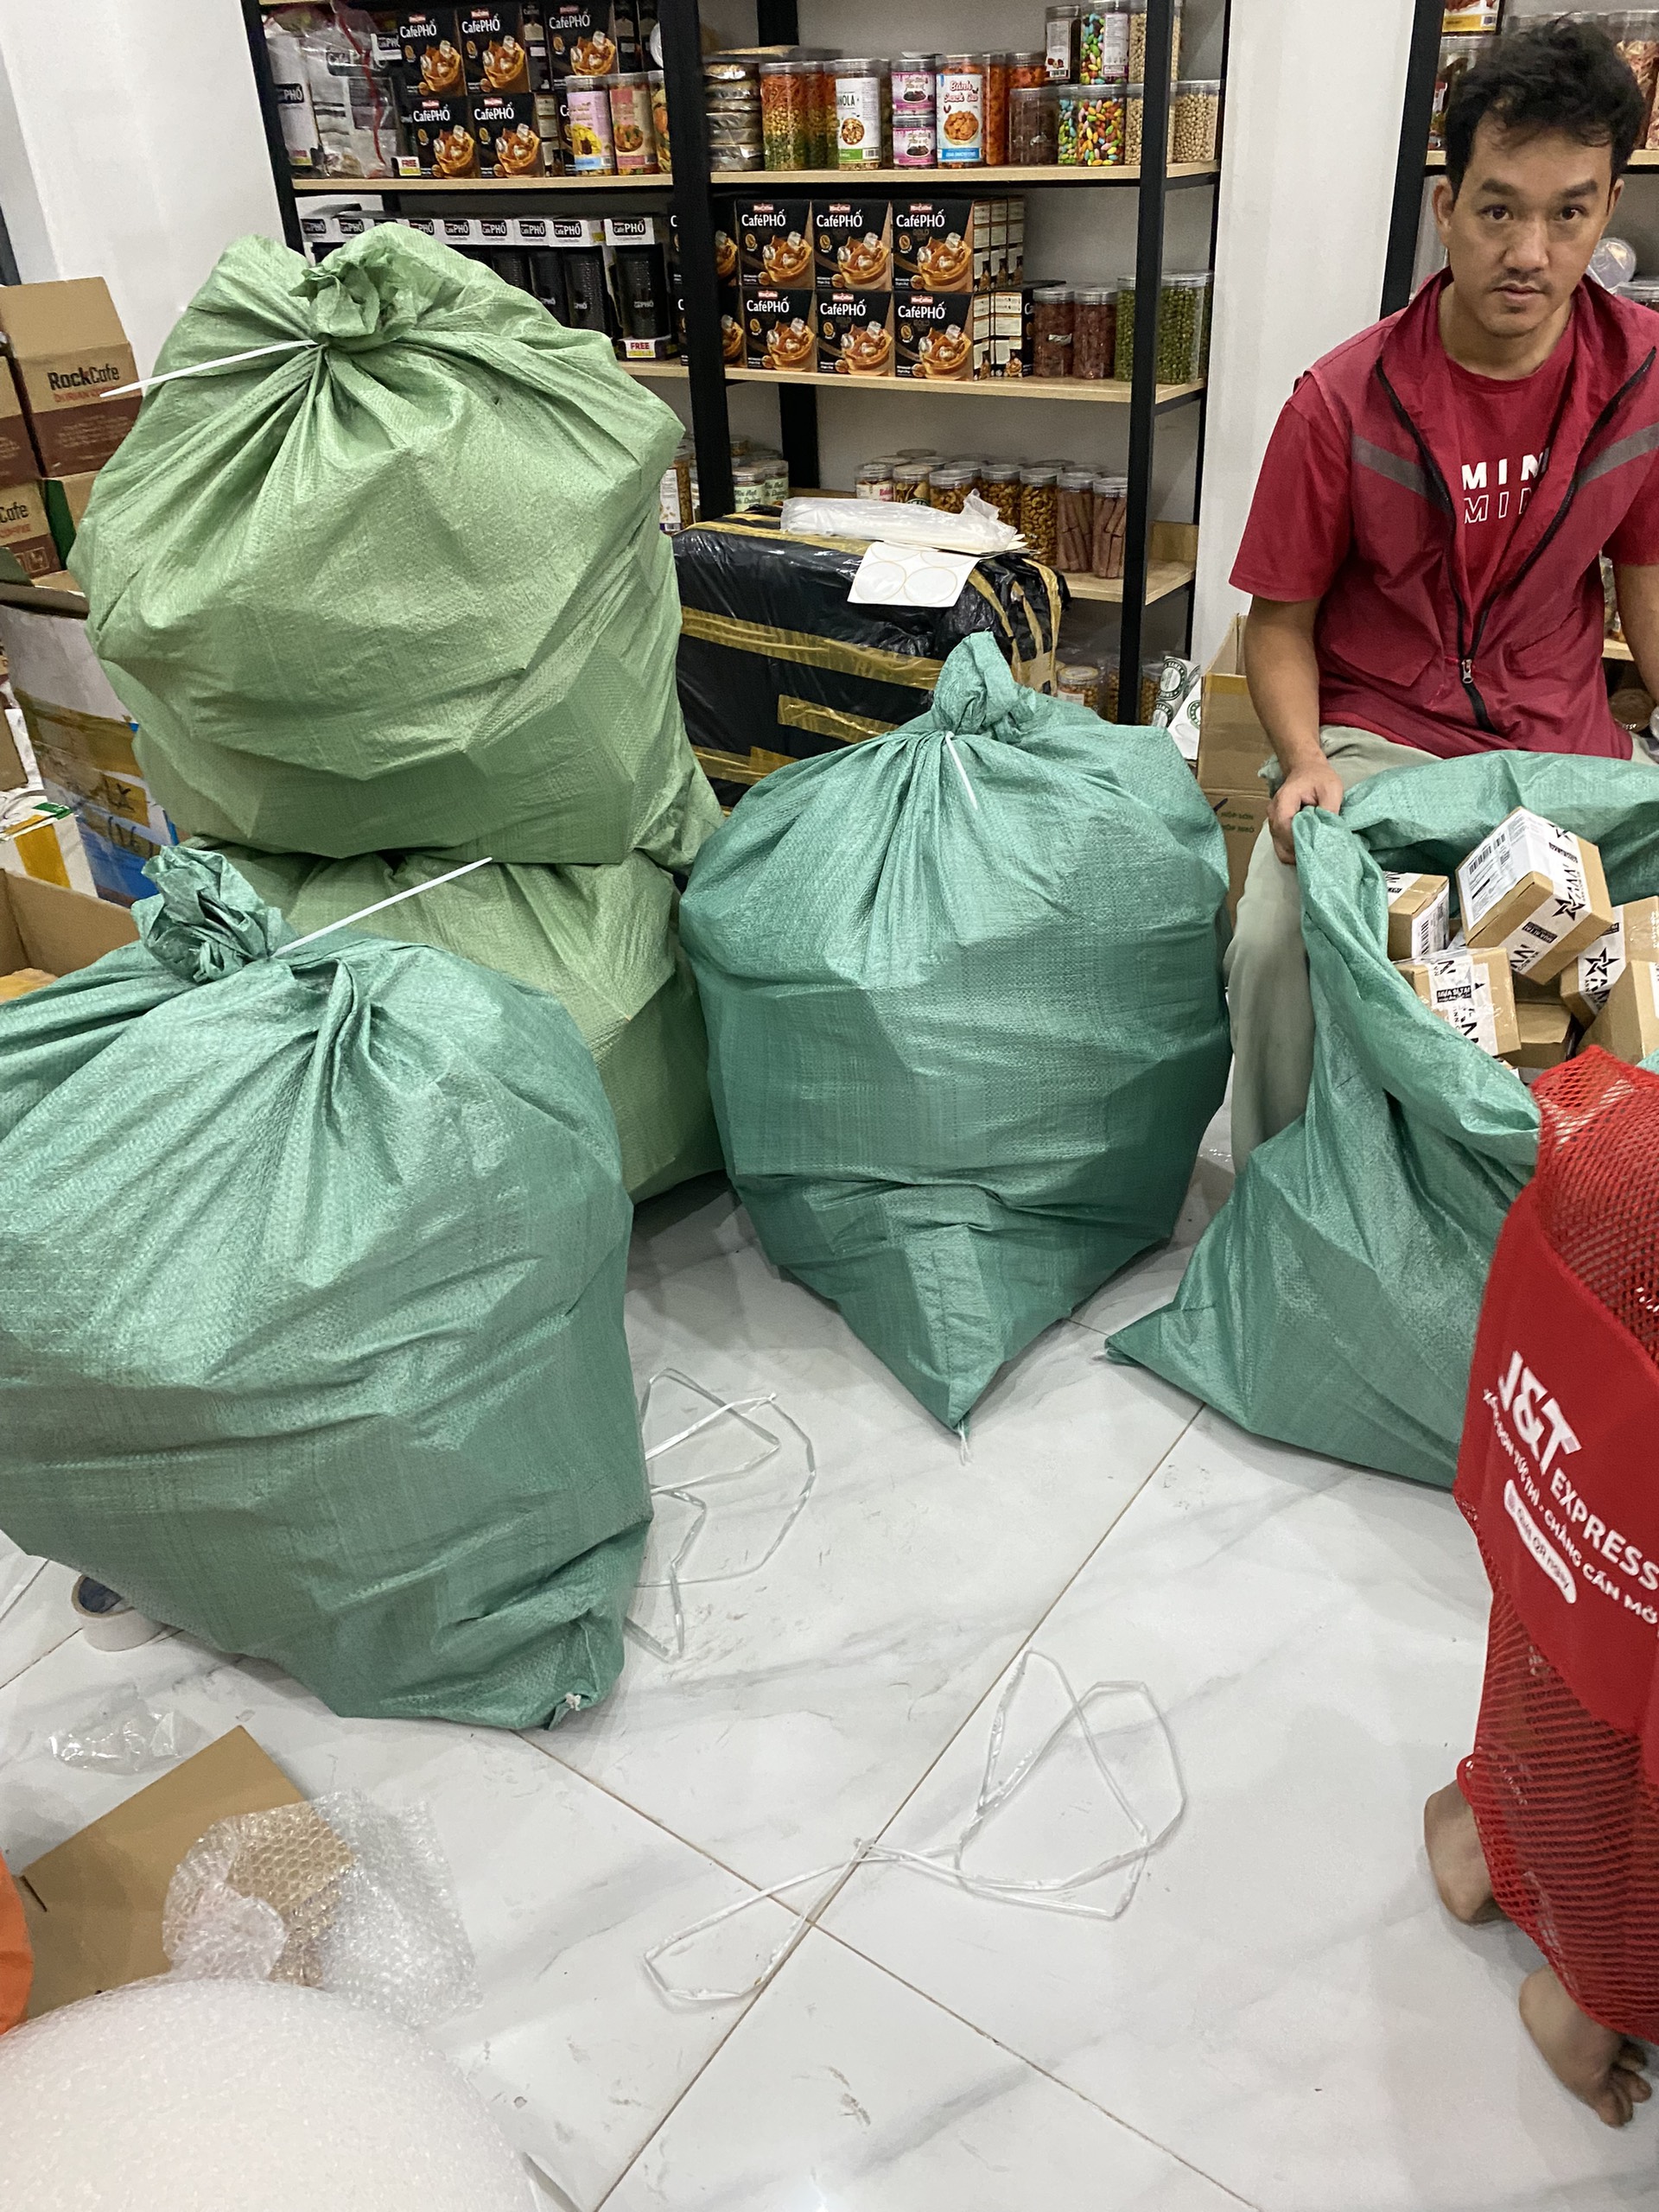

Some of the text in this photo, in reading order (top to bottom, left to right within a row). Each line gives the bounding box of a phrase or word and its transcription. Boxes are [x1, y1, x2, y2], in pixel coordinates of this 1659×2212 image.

[741, 209, 786, 226] CaféPHỐ
[817, 209, 863, 228] CaféPHỐ
[896, 209, 945, 228] CaféPHỐ
[747, 296, 790, 313] CaféPHỐ
[820, 299, 867, 316] CaféPHỐ
[898, 302, 946, 319] CaféPHỐ
[1498, 1351, 1659, 1591] J&T EXPRESS
